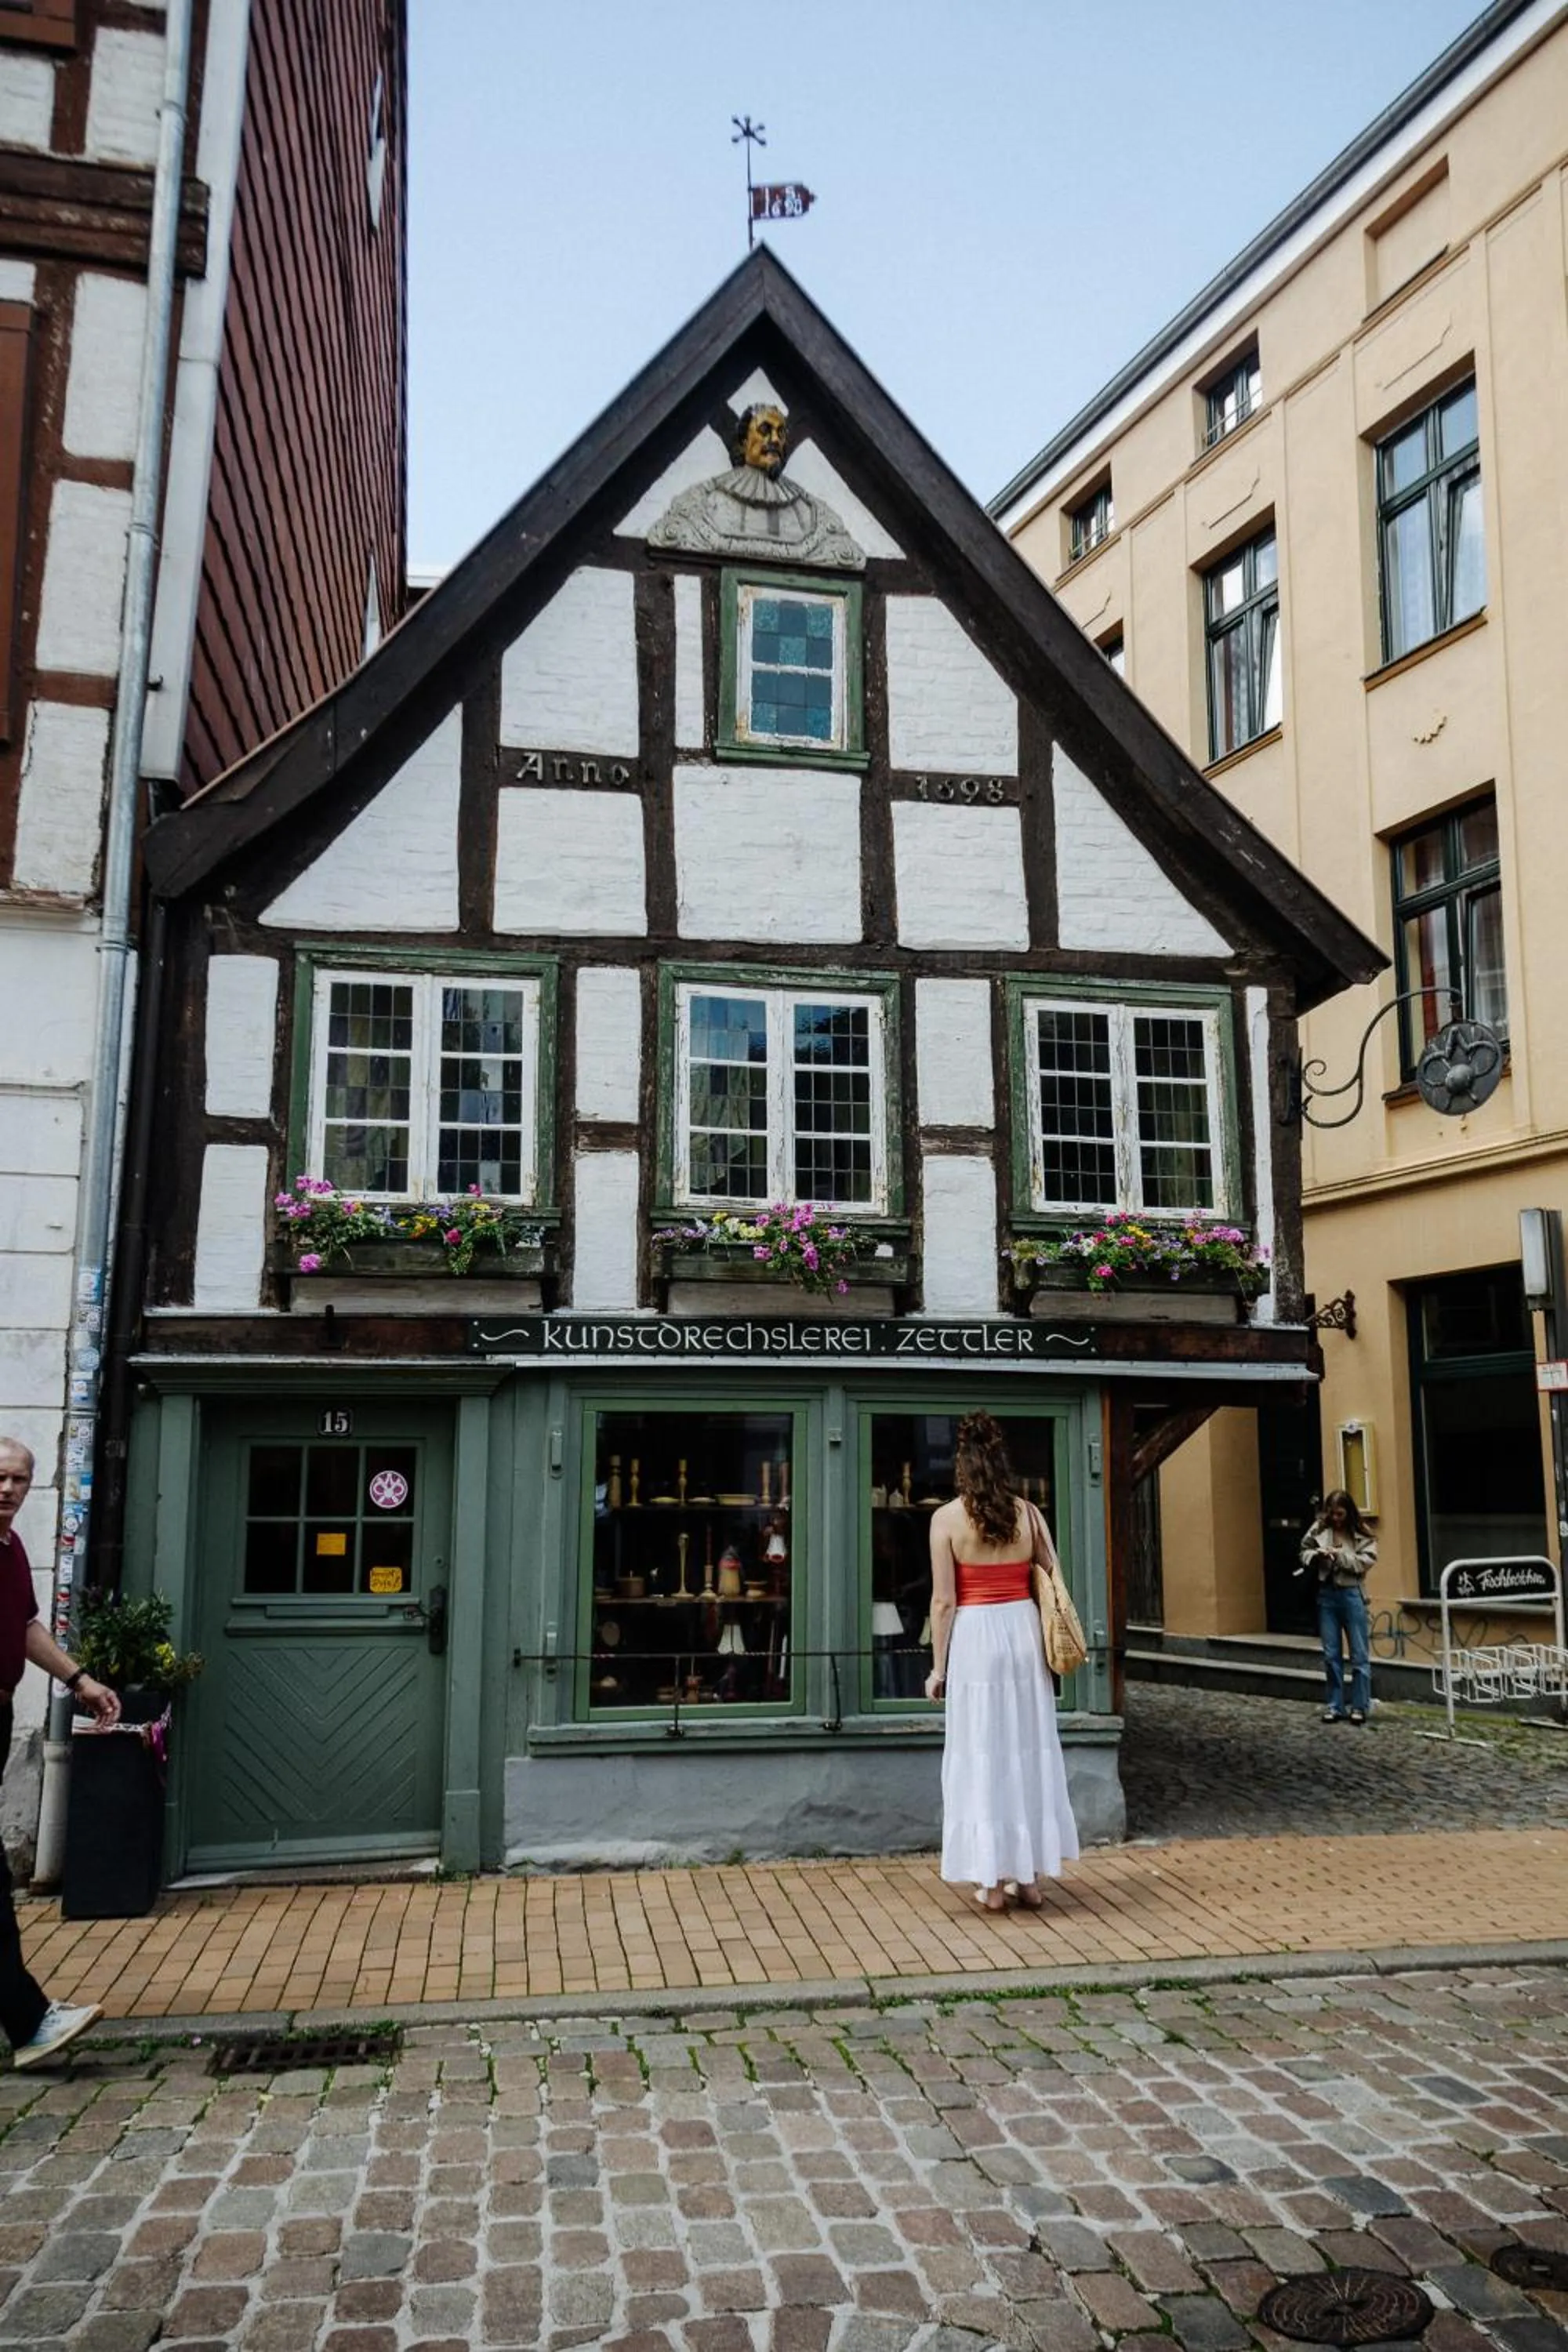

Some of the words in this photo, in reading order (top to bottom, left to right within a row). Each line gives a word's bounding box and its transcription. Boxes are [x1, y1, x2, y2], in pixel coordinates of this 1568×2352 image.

[515, 752, 630, 785] Anno
[916, 775, 1004, 803] 1698
[323, 1410, 348, 1433] 15
